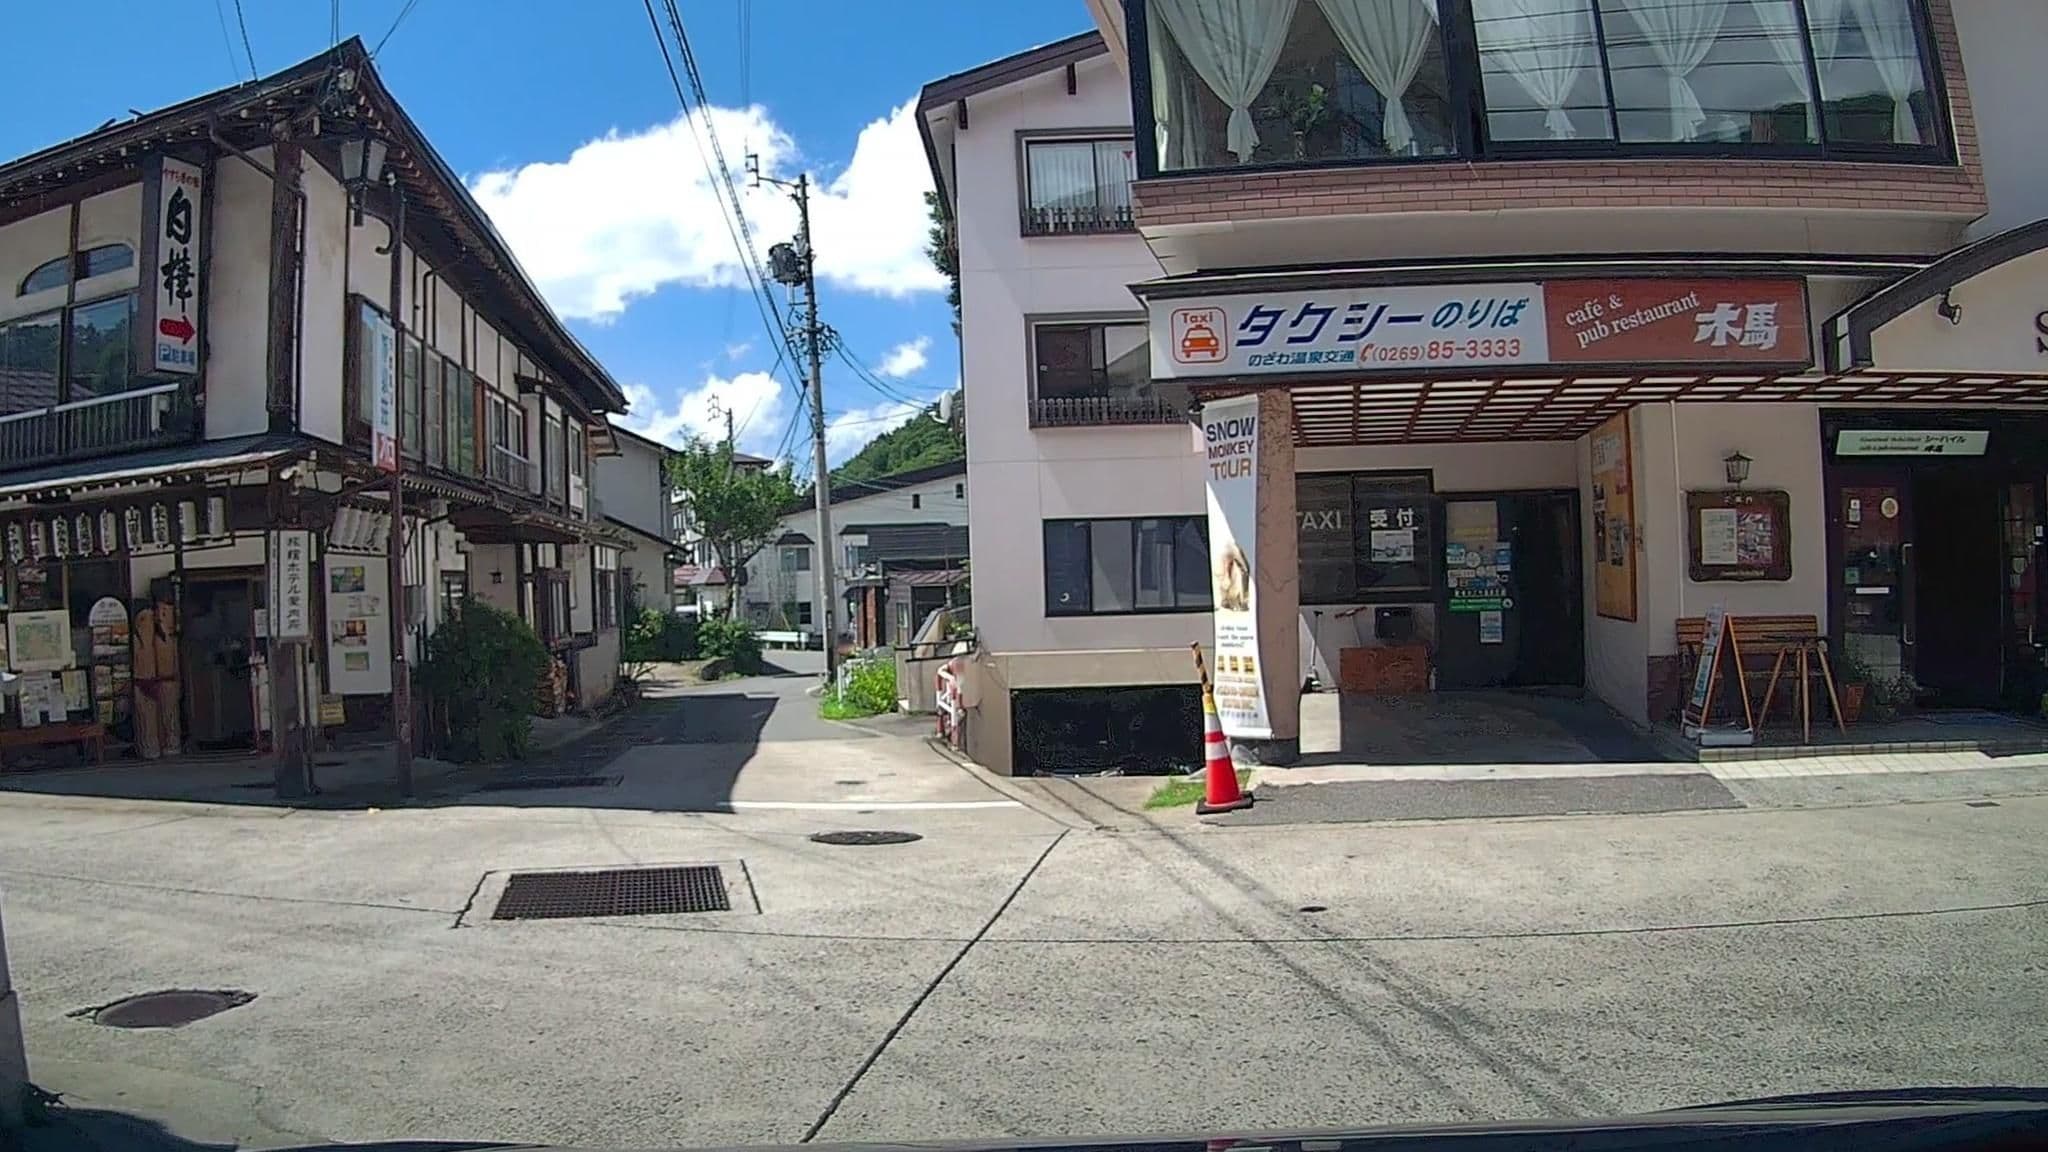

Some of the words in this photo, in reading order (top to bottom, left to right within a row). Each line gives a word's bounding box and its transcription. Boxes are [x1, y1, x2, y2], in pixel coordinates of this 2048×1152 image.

[160, 186, 195, 312] 白樺
[1182, 312, 1214, 324] Taxi
[1565, 299, 1604, 326] café
[1608, 293, 1624, 310] &
[1576, 322, 1609, 348] pub
[1613, 290, 1700, 334] restaurant
[1235, 298, 1530, 347] タクシーのりば
[1694, 302, 1780, 350] 木馬
[1248, 350, 1355, 367] のざわ温泉交通
[1373, 338, 1521, 362] (0269)85-3333
[1206, 416, 1255, 442] SNOW
[1208, 439, 1254, 459] MONKEY
[1210, 458, 1251, 480] TOUR
[1370, 508, 1414, 528] 受付
